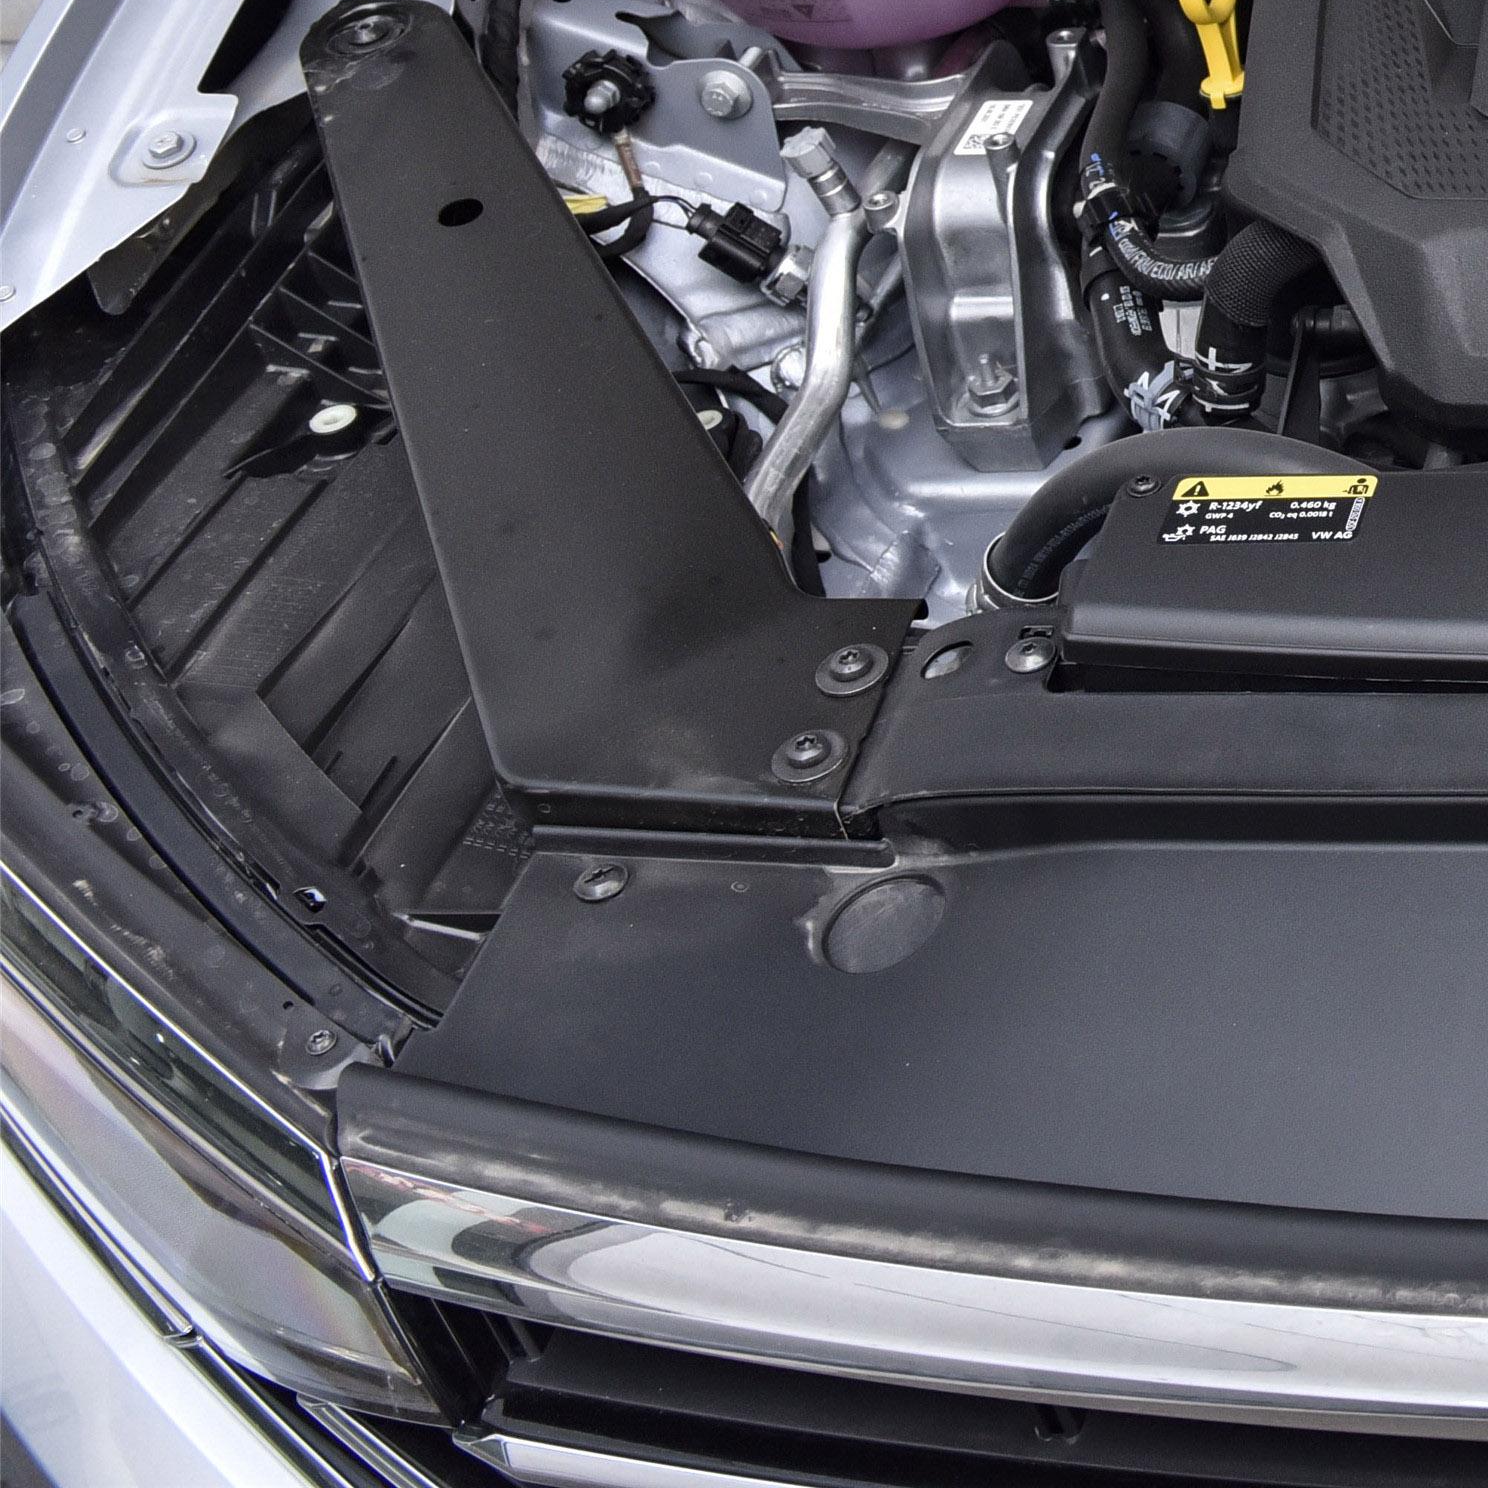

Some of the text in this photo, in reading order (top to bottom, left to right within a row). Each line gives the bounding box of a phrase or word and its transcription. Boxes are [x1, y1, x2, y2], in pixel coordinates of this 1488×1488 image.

[1209, 500, 1263, 512] R-1234yf
[1290, 500, 1336, 510] 0.460 kg
[1200, 525, 1227, 534] PAG
[1312, 531, 1353, 539] VW AG
